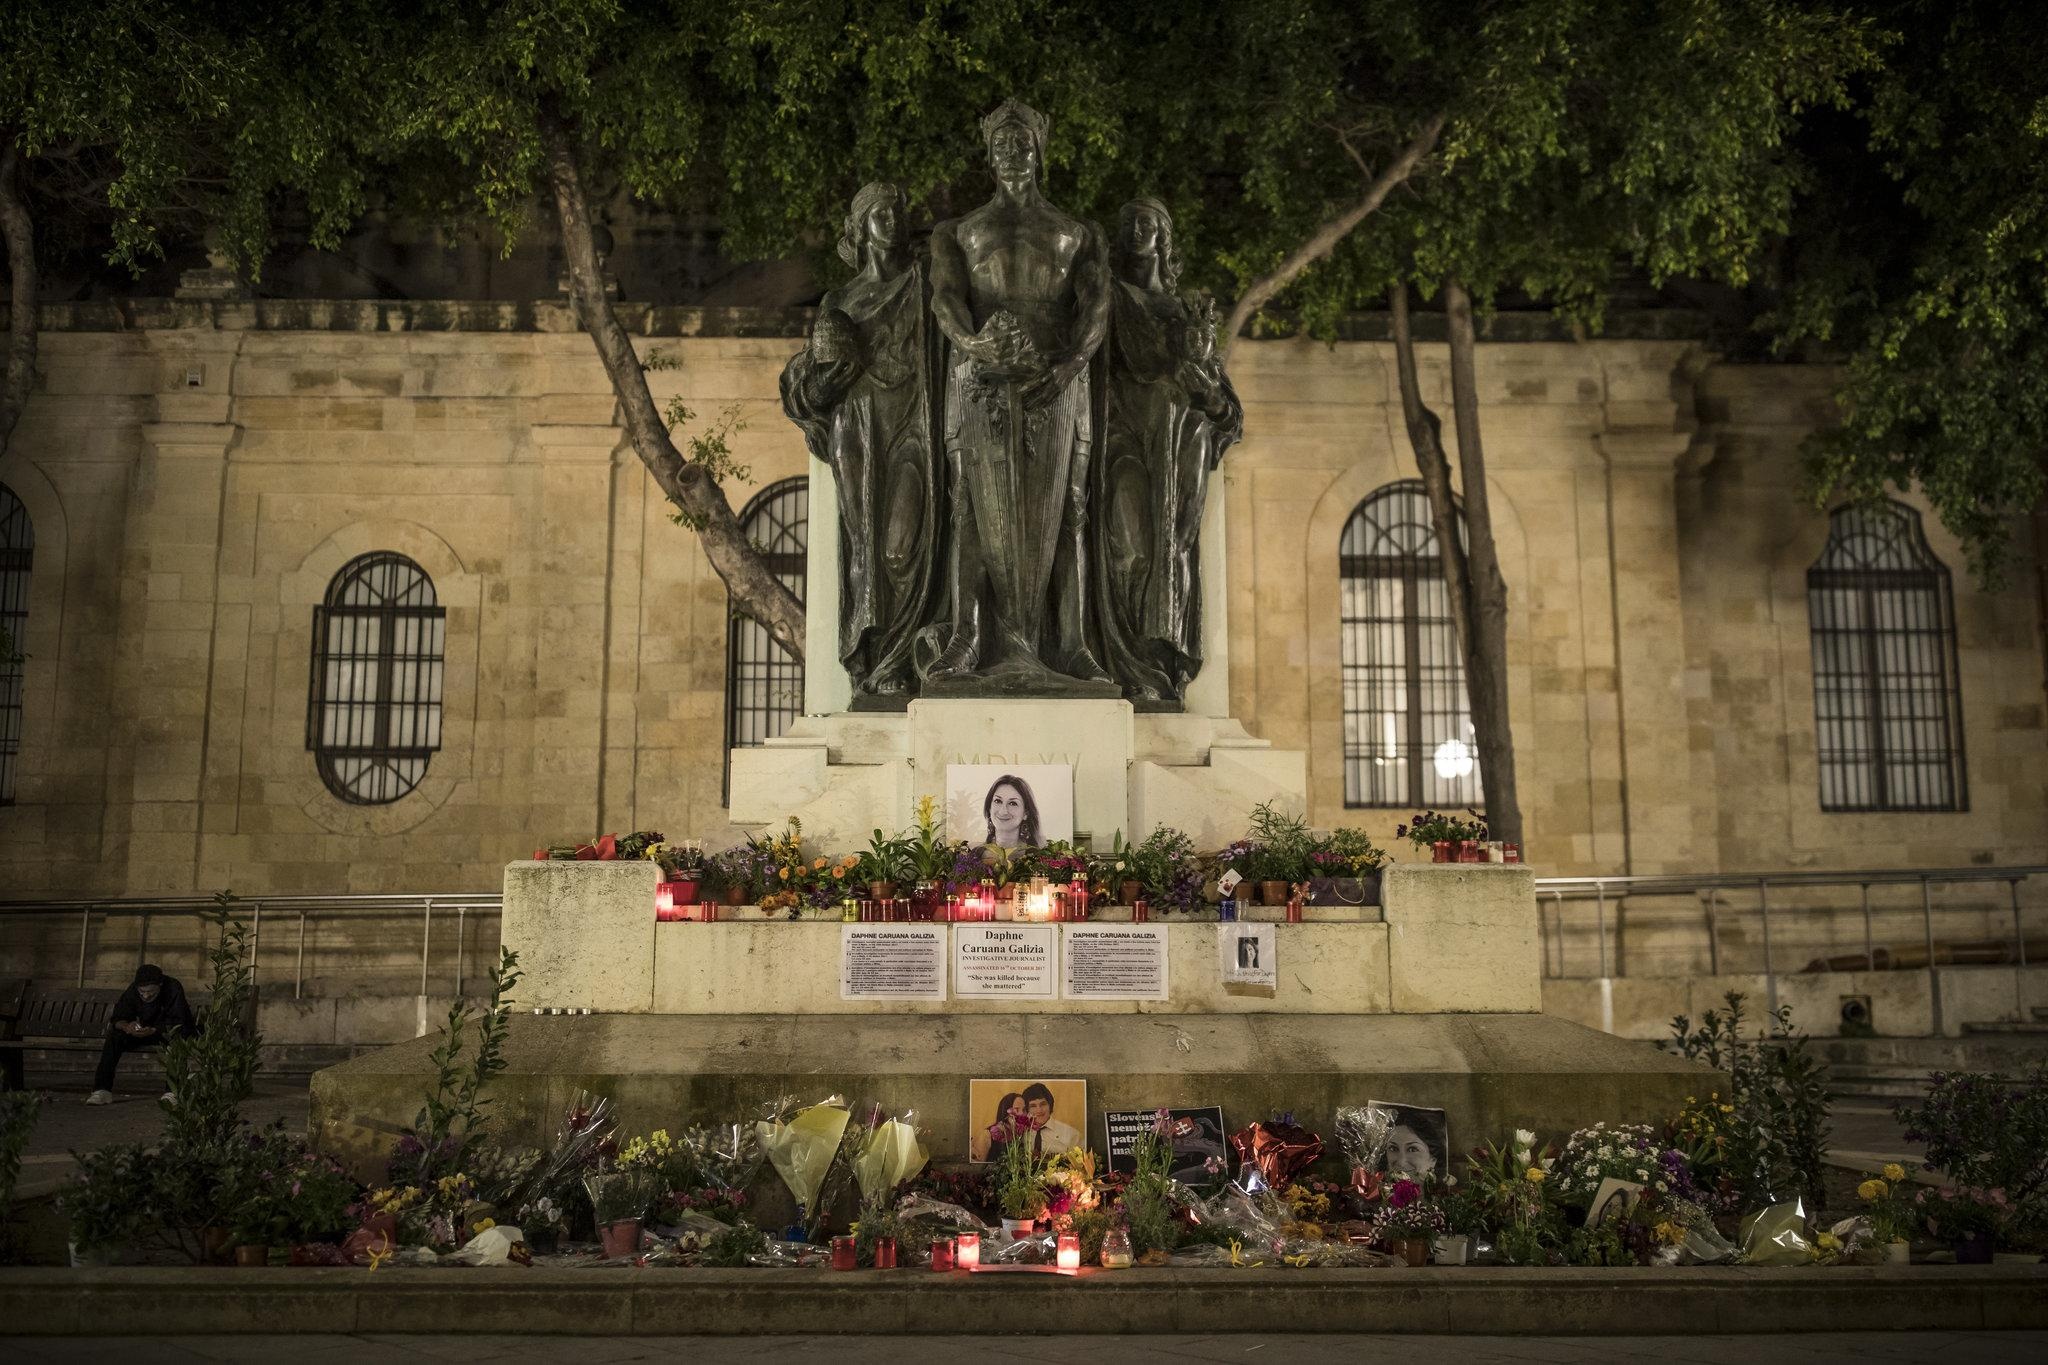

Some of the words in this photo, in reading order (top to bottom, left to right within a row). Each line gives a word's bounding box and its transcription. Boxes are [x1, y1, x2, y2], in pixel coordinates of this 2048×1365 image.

[985, 930, 1024, 942] Daphne
[962, 944, 1006, 954] Caruana
[1008, 944, 1044, 954] Galizia
[1109, 1112, 1170, 1122] Slovens
[1110, 1122, 1154, 1132] nemôž
